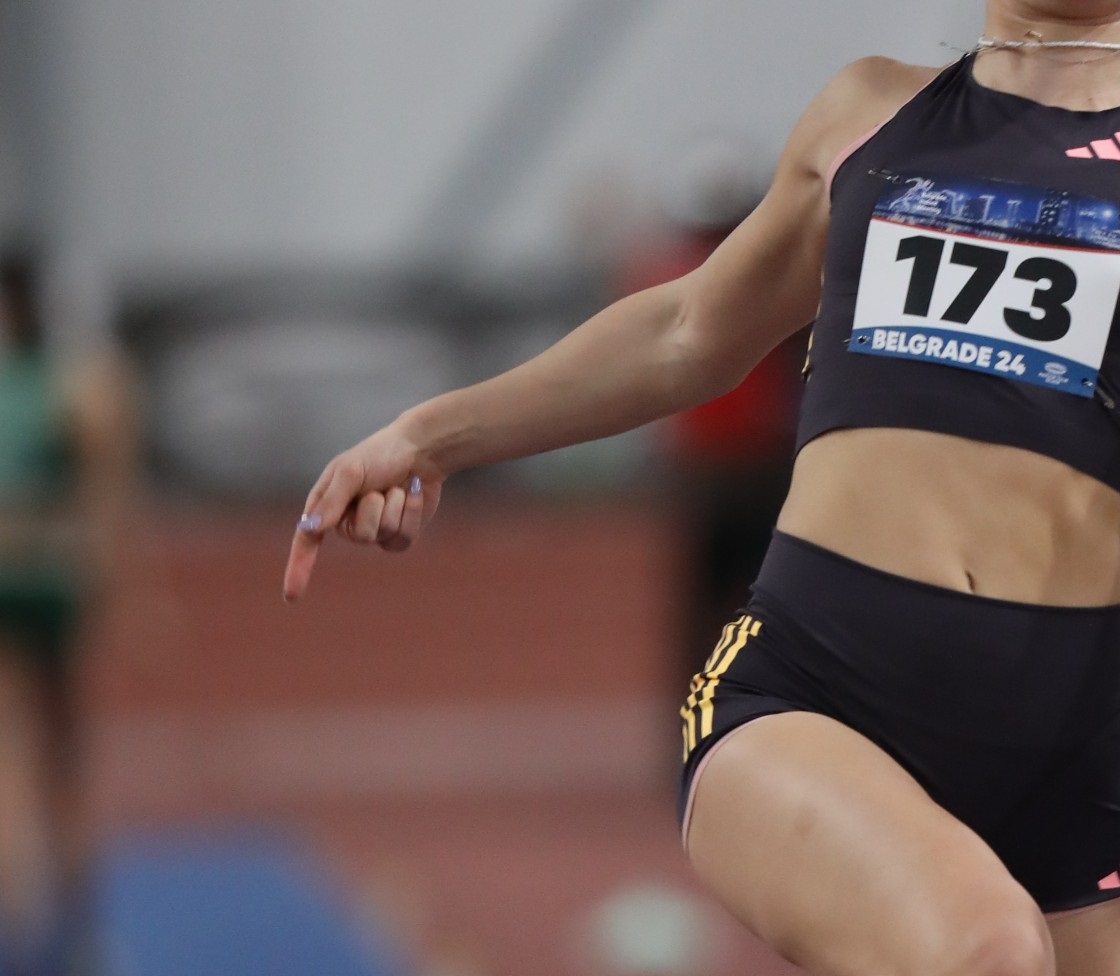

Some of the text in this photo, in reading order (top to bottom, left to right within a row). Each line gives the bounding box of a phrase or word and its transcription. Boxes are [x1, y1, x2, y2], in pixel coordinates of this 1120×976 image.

[895, 235, 1077, 342] 173
[872, 329, 1027, 376] BELGRADE 24
